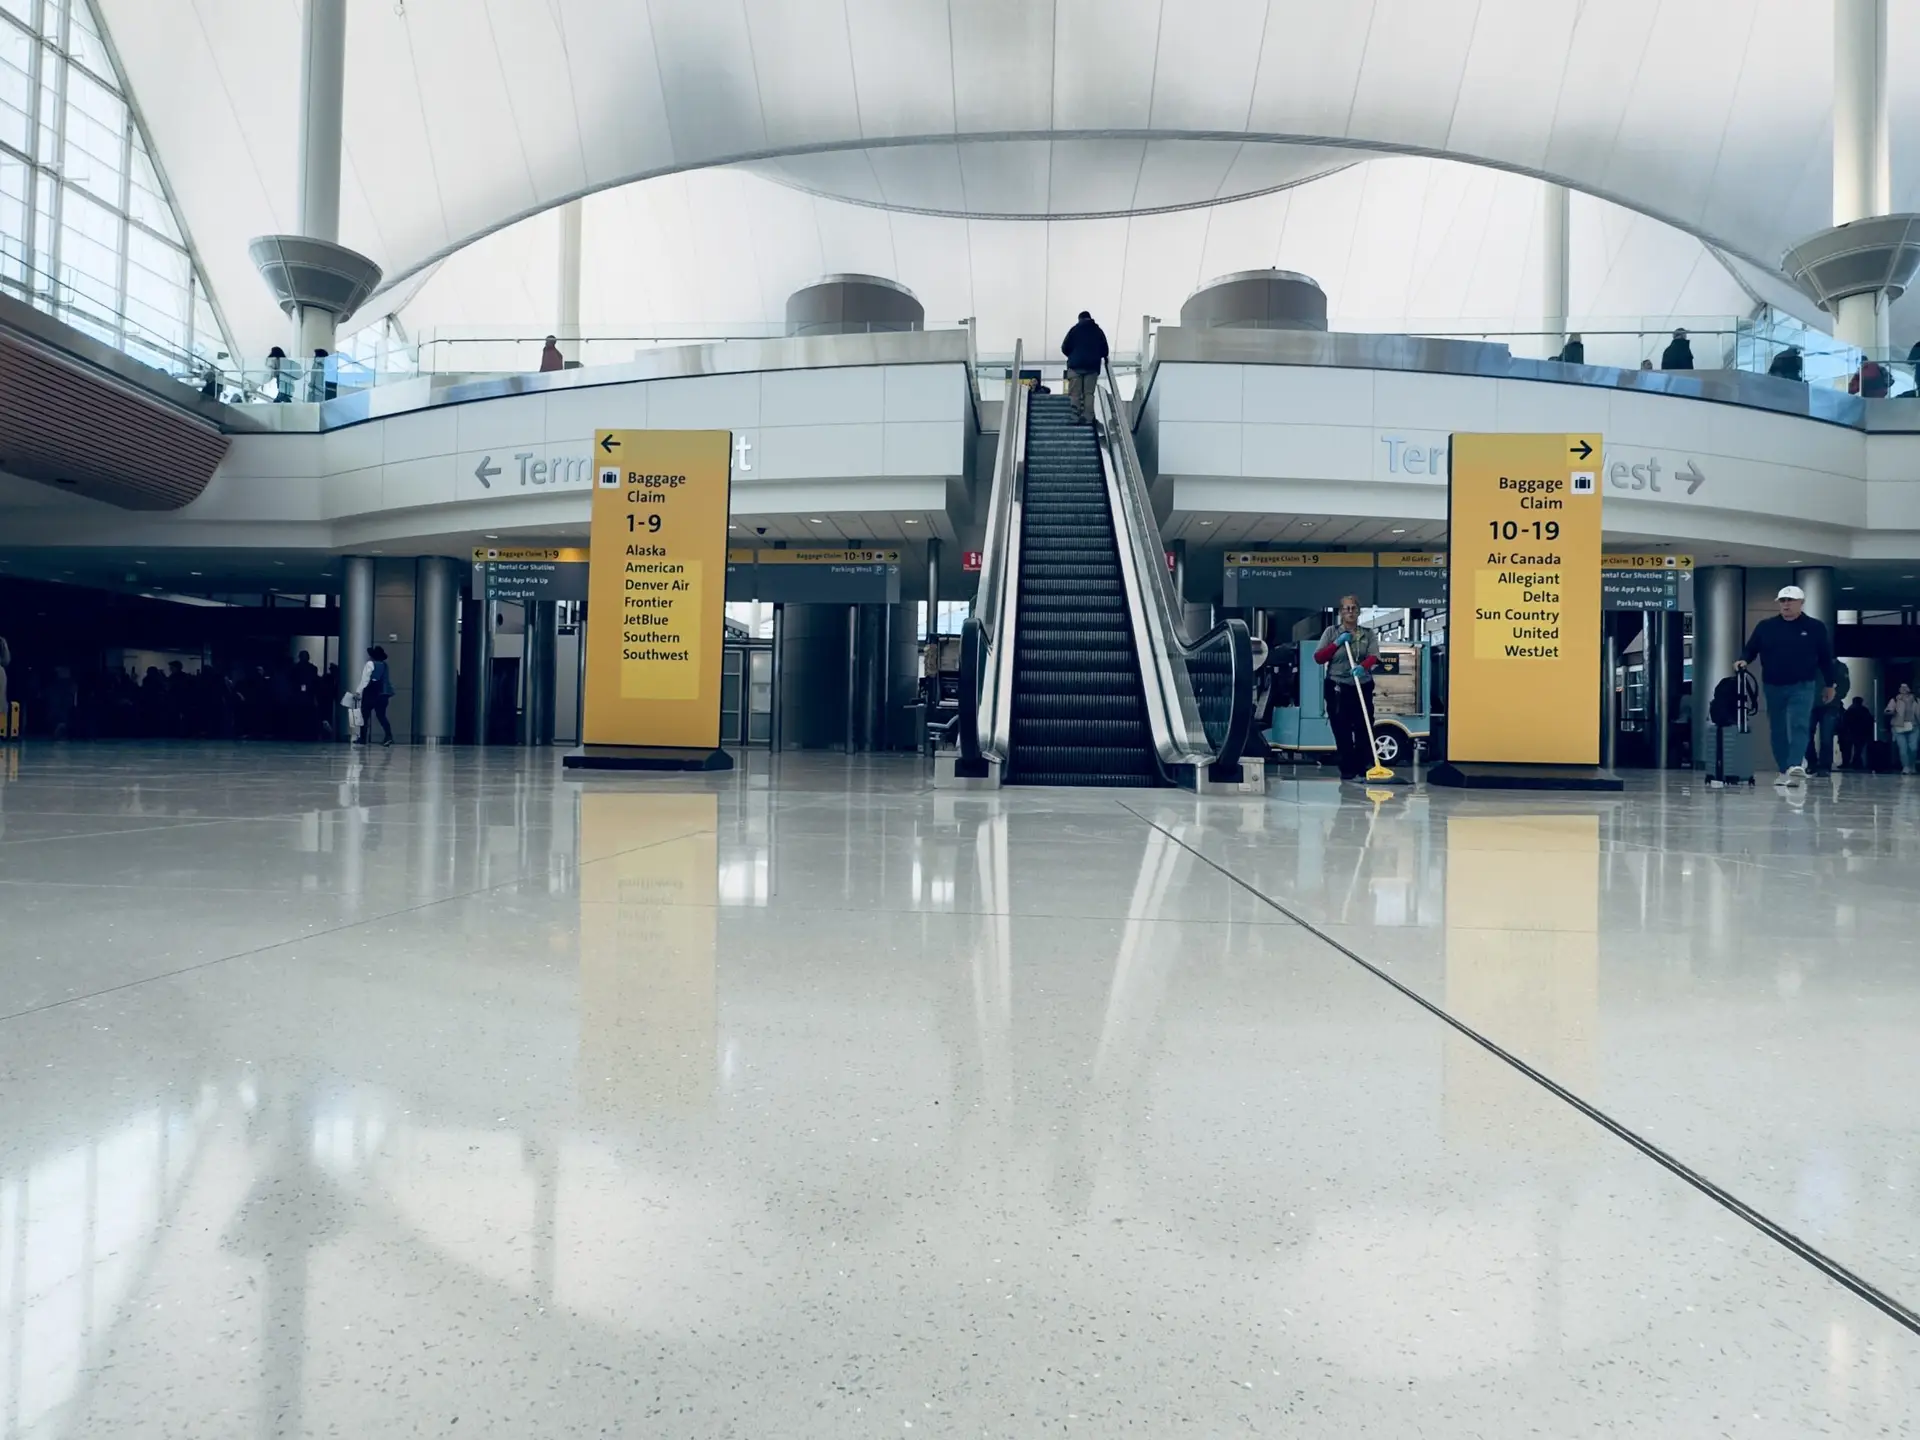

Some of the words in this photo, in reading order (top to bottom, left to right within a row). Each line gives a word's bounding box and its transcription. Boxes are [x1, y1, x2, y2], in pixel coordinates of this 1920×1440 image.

[1603, 452, 1661, 492] est
[628, 472, 686, 488] Baggage
[1499, 477, 1563, 493] Baggage
[627, 491, 665, 503] Claim
[1520, 496, 1562, 509] Claim
[626, 514, 662, 533] 1-9
[1489, 521, 1559, 540] 10-19
[544, 550, 559, 559] 1-9
[626, 544, 666, 556] Alaska
[844, 552, 872, 561] 10-19
[1302, 554, 1319, 564] 1-9
[1487, 552, 1506, 564] Air
[1510, 553, 1561, 565] Canada
[1631, 556, 1663, 566] 10-19
[498, 563, 518, 571] Rental
[518, 563, 529, 571] Car
[529, 563, 555, 571] Shuttles
[625, 562, 684, 573] American
[831, 566, 855, 574] Parking
[1251, 570, 1277, 578] Parking
[1424, 569, 1438, 578] City
[512, 577, 525, 585] App
[540, 577, 549, 585] Up
[625, 579, 669, 590] Denver
[672, 580, 690, 591] Air
[1498, 572, 1560, 588] Allegiant
[498, 590, 521, 598] Parking
[1621, 586, 1635, 594] App
[1652, 586, 1663, 594] Up
[624, 596, 674, 608] Frontier
[1523, 590, 1559, 603] Delta
[1617, 600, 1643, 608] Parking
[623, 614, 669, 626] JetBlue
[1476, 608, 1501, 620] Sun
[1505, 609, 1560, 624] Country
[623, 631, 680, 643] Southern
[1513, 627, 1559, 639] United
[623, 648, 689, 661] Southwest
[1504, 645, 1559, 657] WestJet
